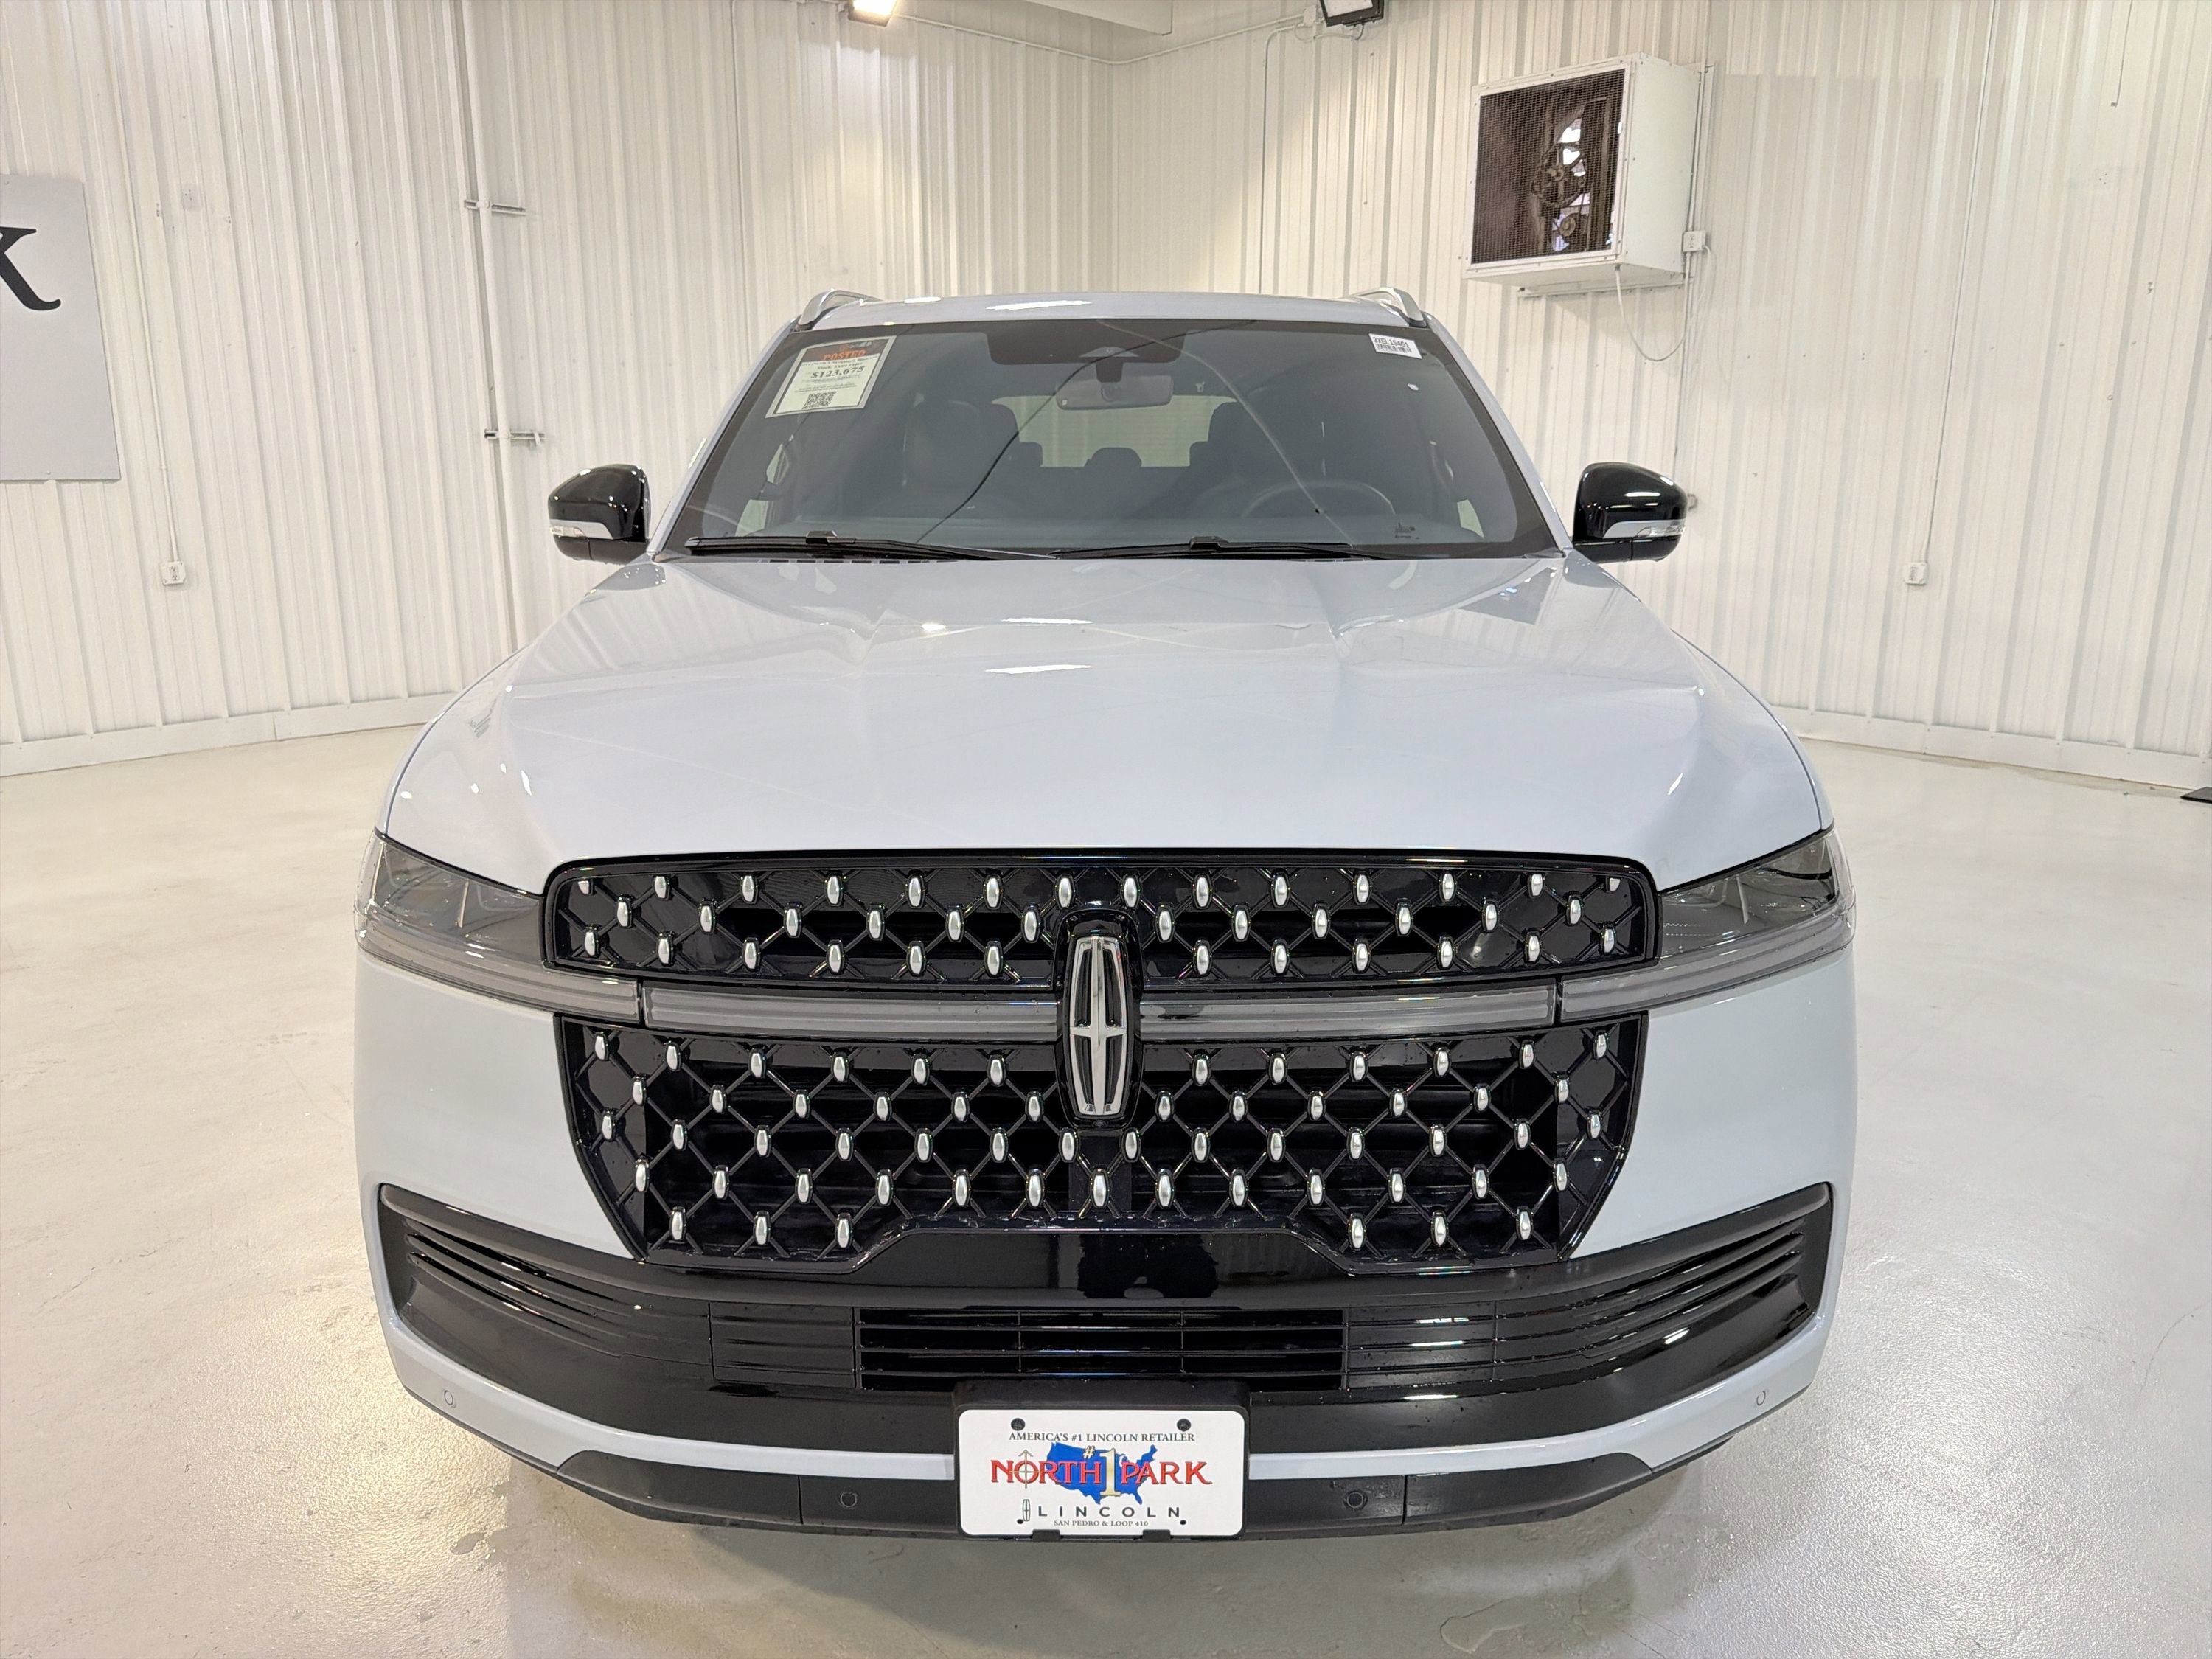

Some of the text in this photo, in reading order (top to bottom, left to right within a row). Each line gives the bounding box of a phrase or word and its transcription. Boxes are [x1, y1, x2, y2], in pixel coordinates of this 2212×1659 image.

[823, 349, 866, 361] POSTED
[811, 366, 865, 378] $123,675
[1008, 1432, 1195, 1442] AMERICA'S #1 LINCOLN RETAILER
[990, 1459, 1213, 1485] NORTH PARK
[1038, 1506, 1180, 1517] LINCOLN
